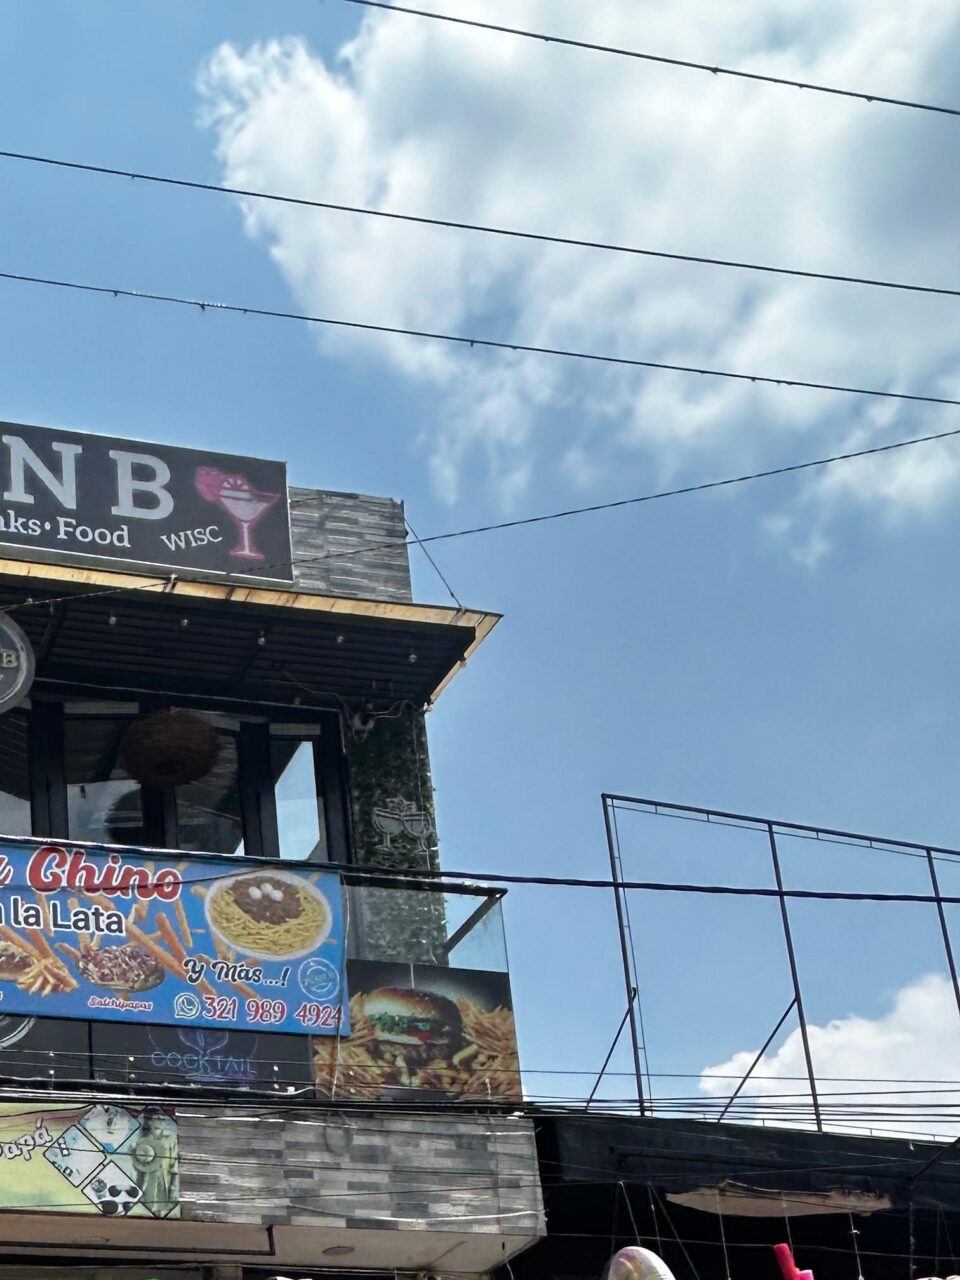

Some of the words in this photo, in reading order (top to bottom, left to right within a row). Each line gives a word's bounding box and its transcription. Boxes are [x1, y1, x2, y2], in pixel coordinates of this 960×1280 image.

[111, 450, 174, 520] B
[56, 516, 131, 548] Food
[160, 525, 222, 552] WISC
[0, 648, 18, 668] B
[26, 845, 182, 902] Chino
[11, 896, 44, 928] la
[50, 900, 126, 936] Lata
[202, 995, 238, 1021] 321
[245, 998, 287, 1024] 989
[294, 1003, 344, 1028] 4924
